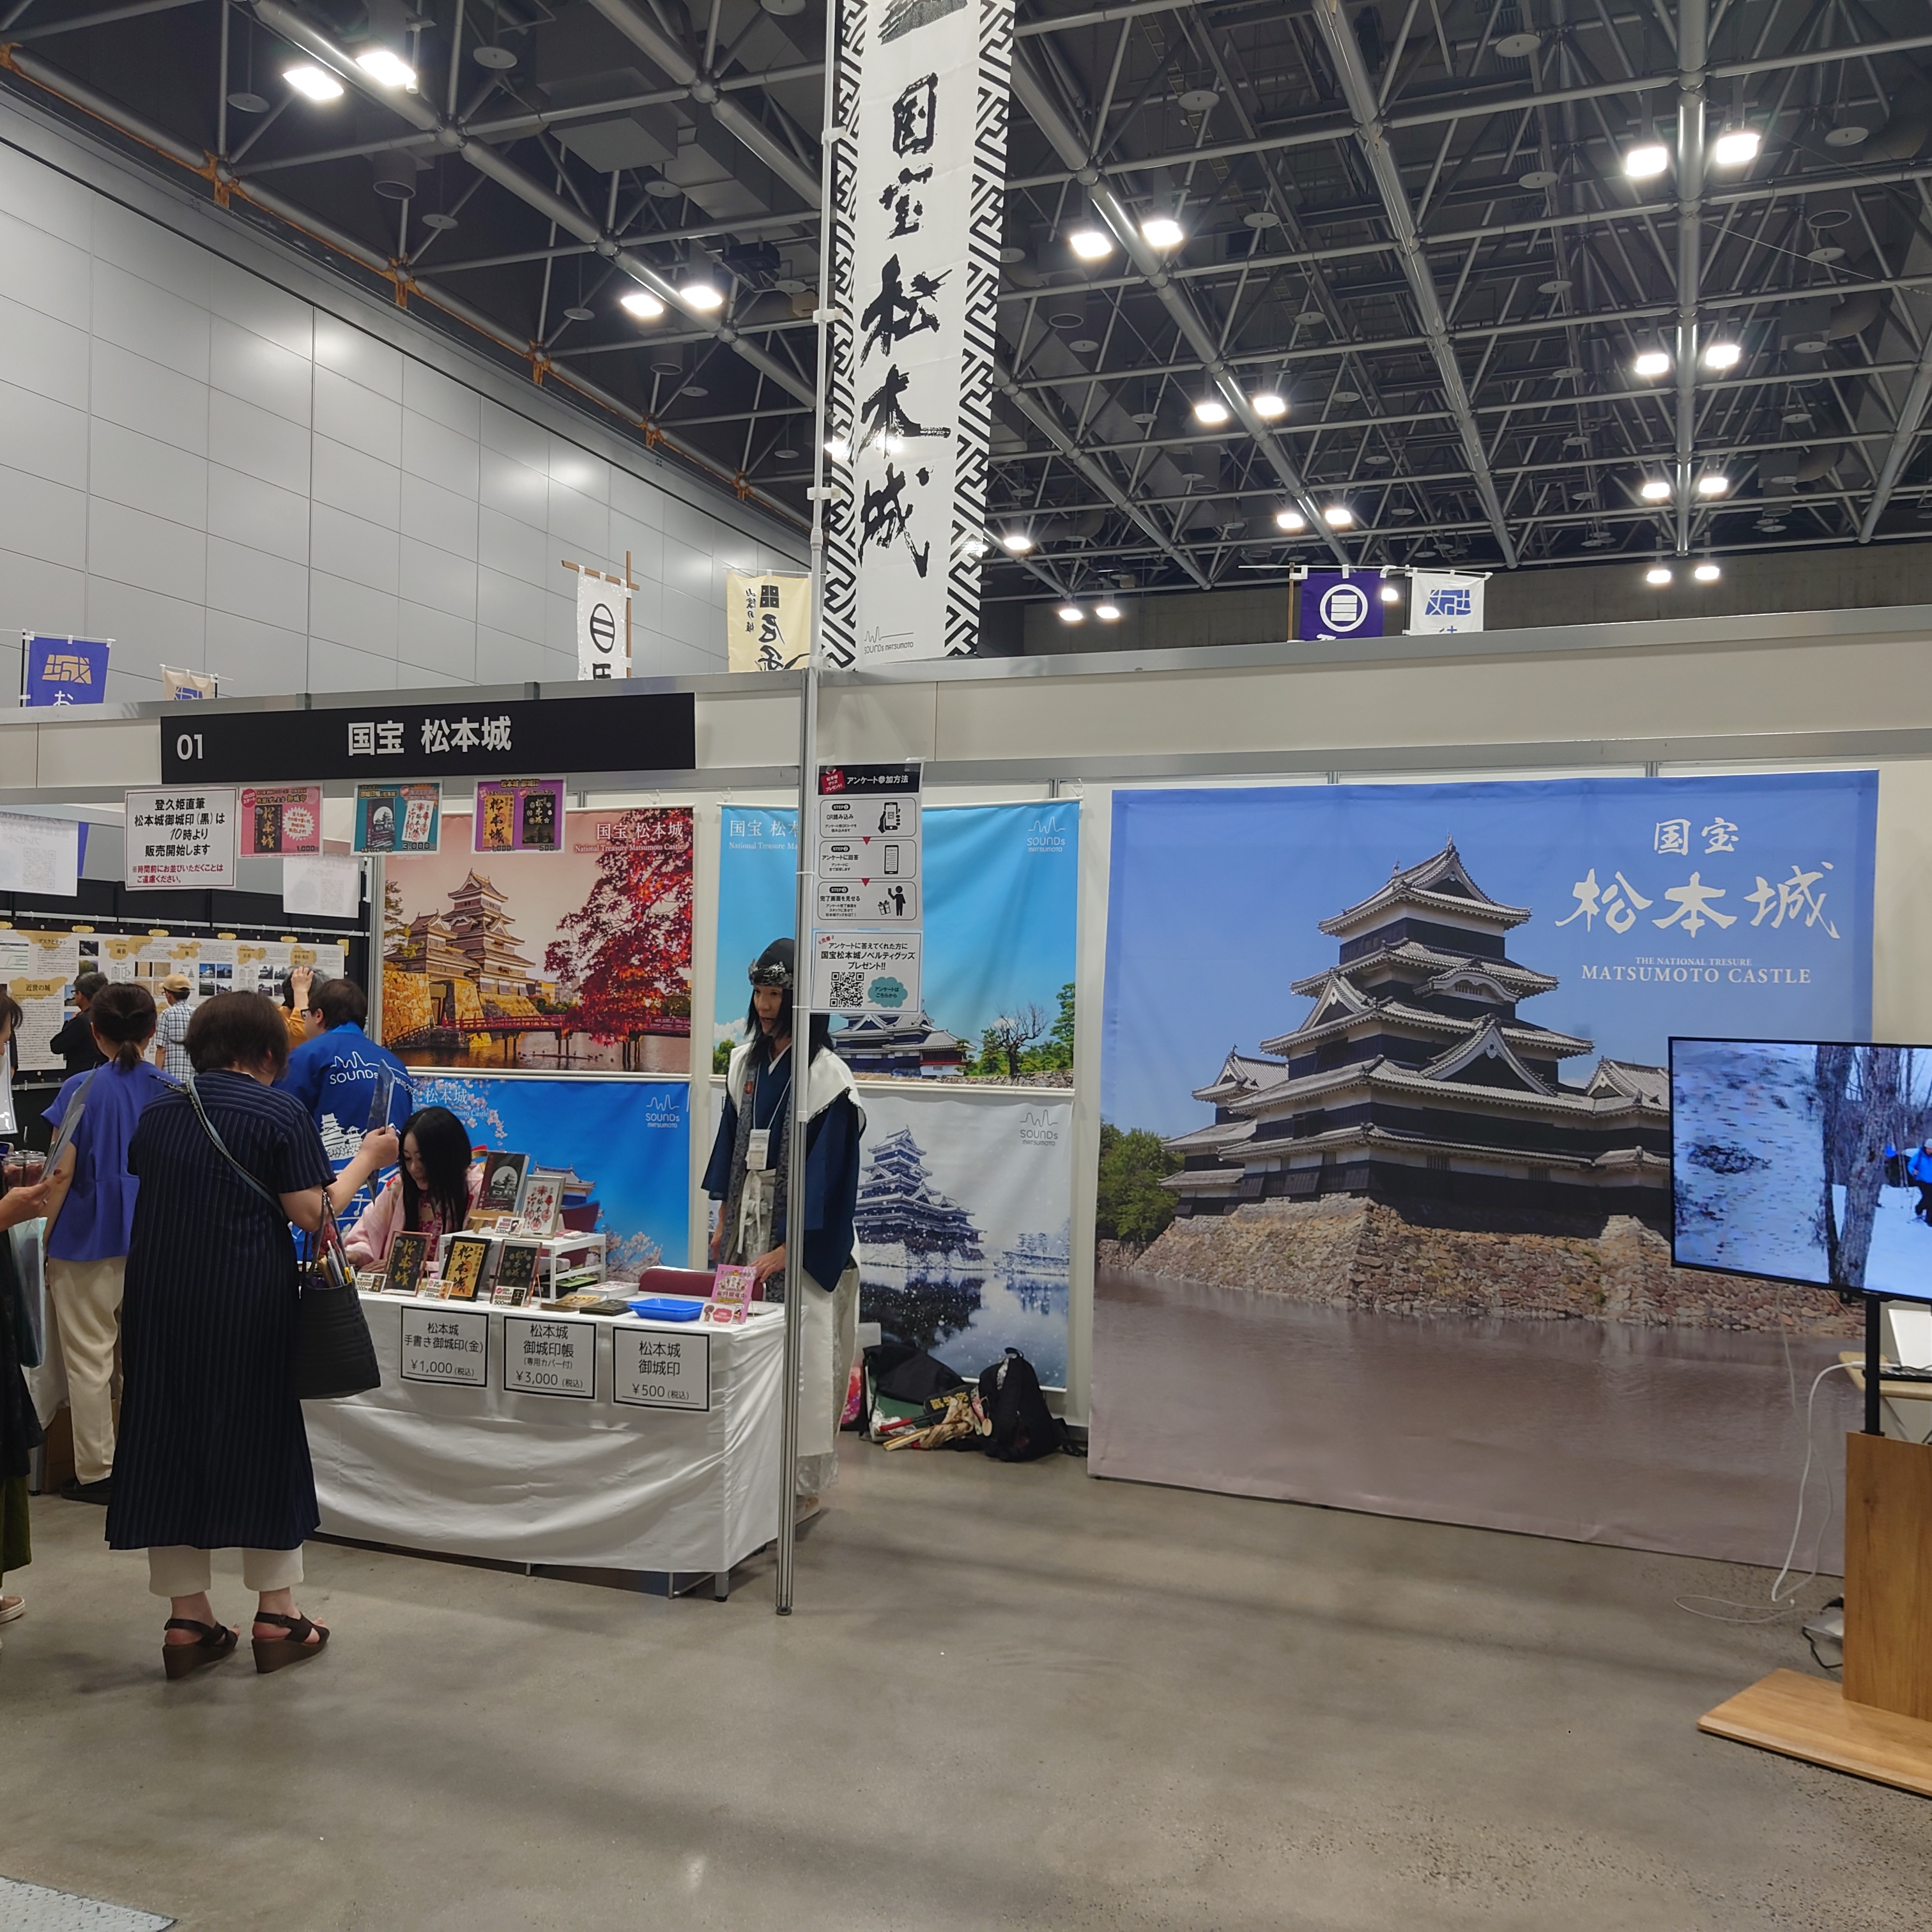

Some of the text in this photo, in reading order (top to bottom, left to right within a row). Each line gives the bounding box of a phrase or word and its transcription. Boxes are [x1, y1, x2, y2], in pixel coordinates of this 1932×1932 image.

[885, 641, 914, 651] MATSUMOTO
[349, 716, 511, 756] 国宝 松本城
[178, 735, 203, 760] 01
[847, 775, 908, 785] アンケート参加方法
[155, 798, 205, 811] 登久姫直筆
[597, 822, 683, 839] 国宝 松本城
[730, 820, 762, 837] 国宝
[1654, 817, 1739, 855] 国宝
[145, 844, 211, 857] 販売開始します
[1555, 861, 1840, 939] 松本城
[821, 951, 916, 960] 国宝松本城ノベルティグッズ
[1581, 965, 1811, 984] MATSUMOTO CASTLE
[425, 1087, 467, 1105] 松本城
[427, 1322, 459, 1336] 松本城
[530, 1323, 569, 1340] 松本城
[404, 1334, 484, 1353] 手書き御城印(金)
[523, 1340, 574, 1358] 御城印帳
[639, 1340, 681, 1358] 松本城
[523, 1357, 573, 1370] (専用カバー付)
[638, 1359, 680, 1377] 御城印
[516, 1371, 583, 1389] ¥3,000 (税込)
[632, 1383, 689, 1400] ¥500 (税込)
